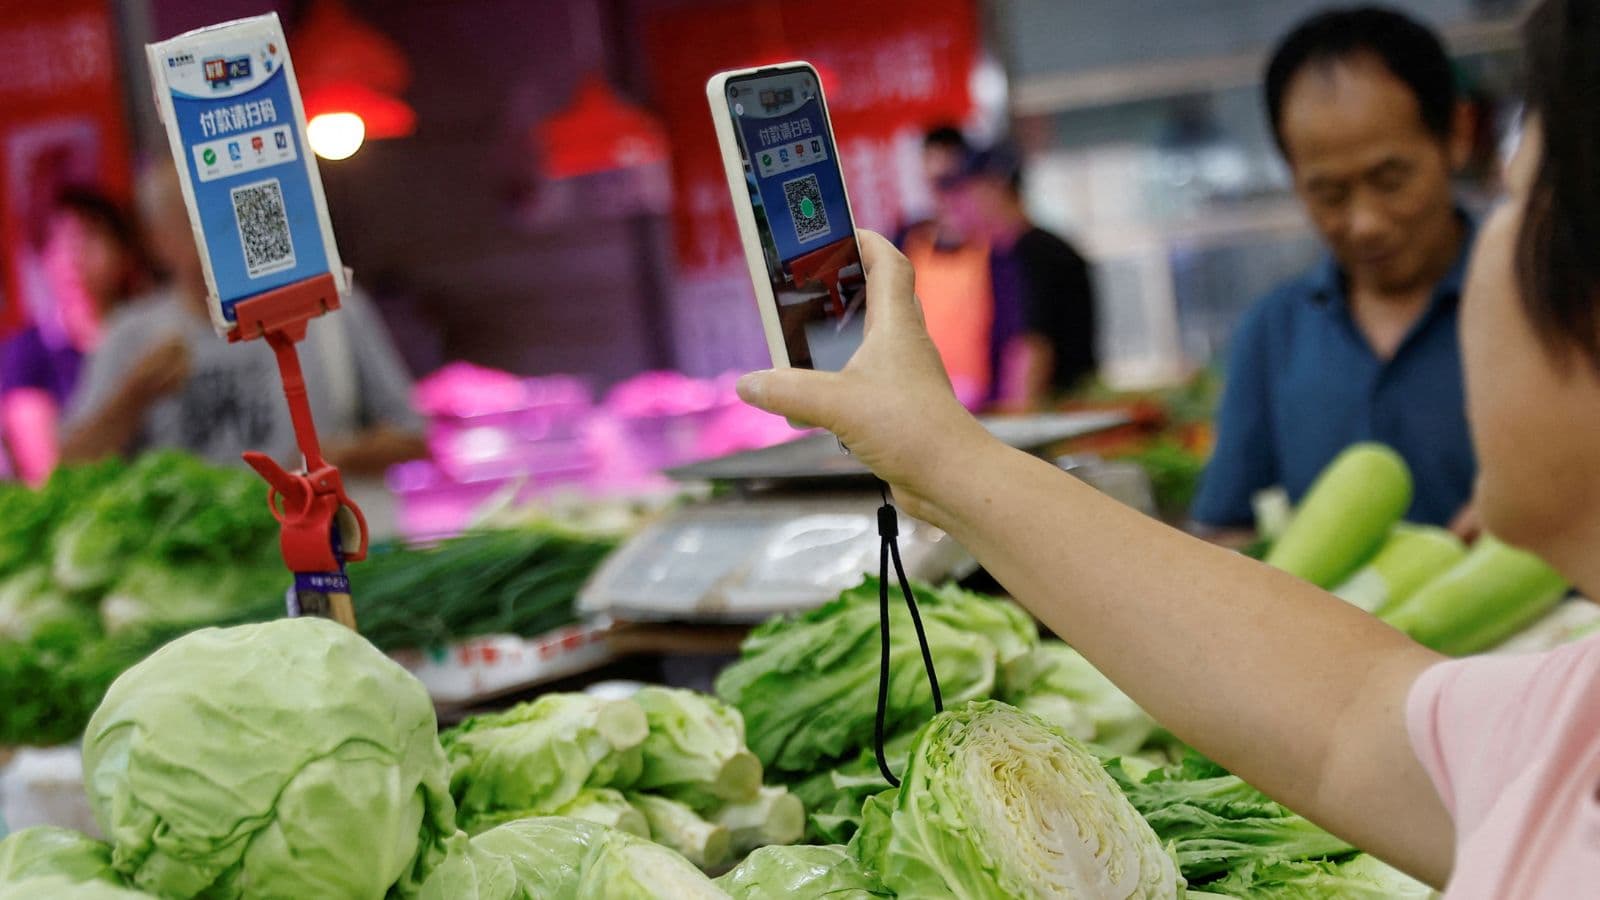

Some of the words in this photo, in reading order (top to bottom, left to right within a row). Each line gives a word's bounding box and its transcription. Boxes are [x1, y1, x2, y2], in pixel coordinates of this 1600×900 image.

[200, 98, 277, 138] 付款请扫码
[759, 118, 813, 146] 付款请扫码
